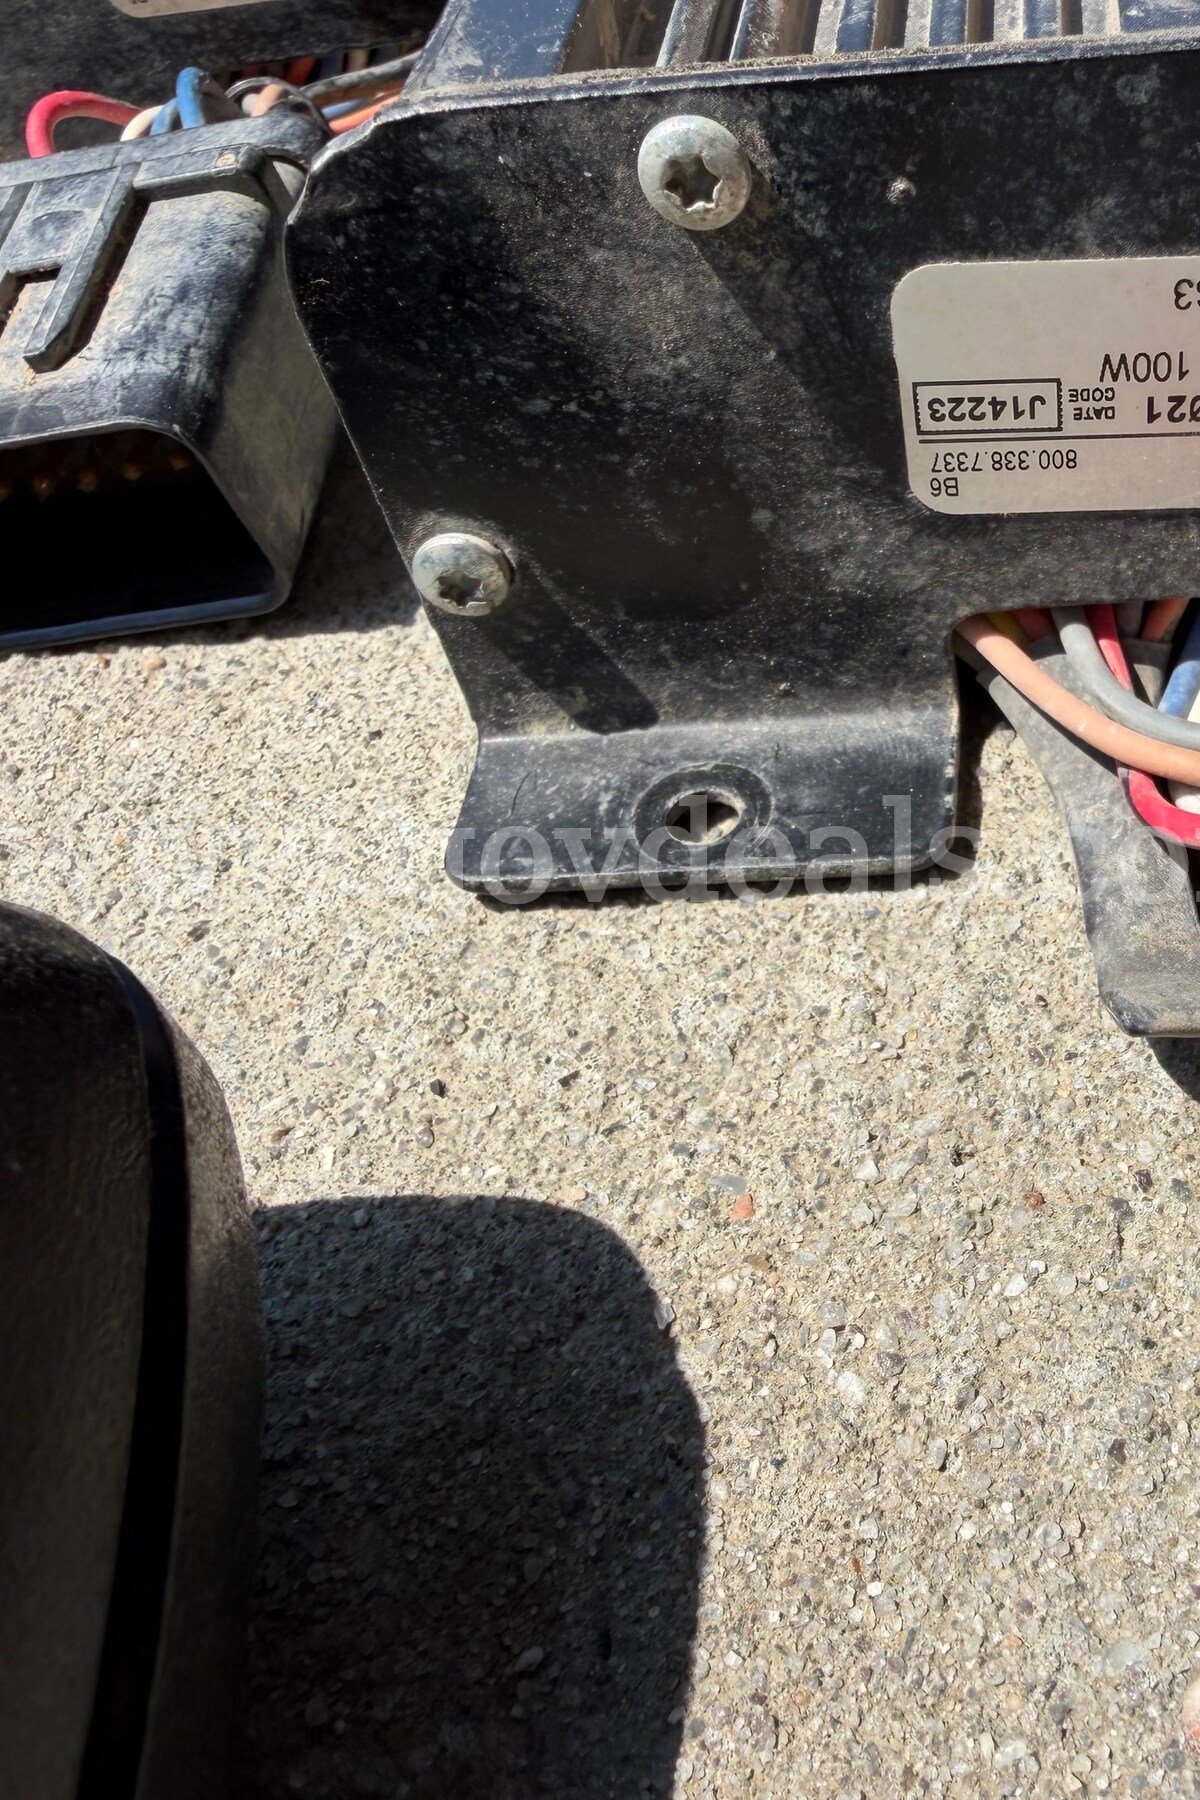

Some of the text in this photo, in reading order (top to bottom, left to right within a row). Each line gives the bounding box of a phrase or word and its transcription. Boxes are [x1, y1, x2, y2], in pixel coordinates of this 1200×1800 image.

[1099, 351, 1188, 383] 100W
[1068, 386, 1116, 402] CODE
[927, 394, 1047, 422] J14223
[1072, 405, 1116, 420] DATE
[930, 448, 1078, 472] 800.338.7337
[929, 476, 960, 496] B6
